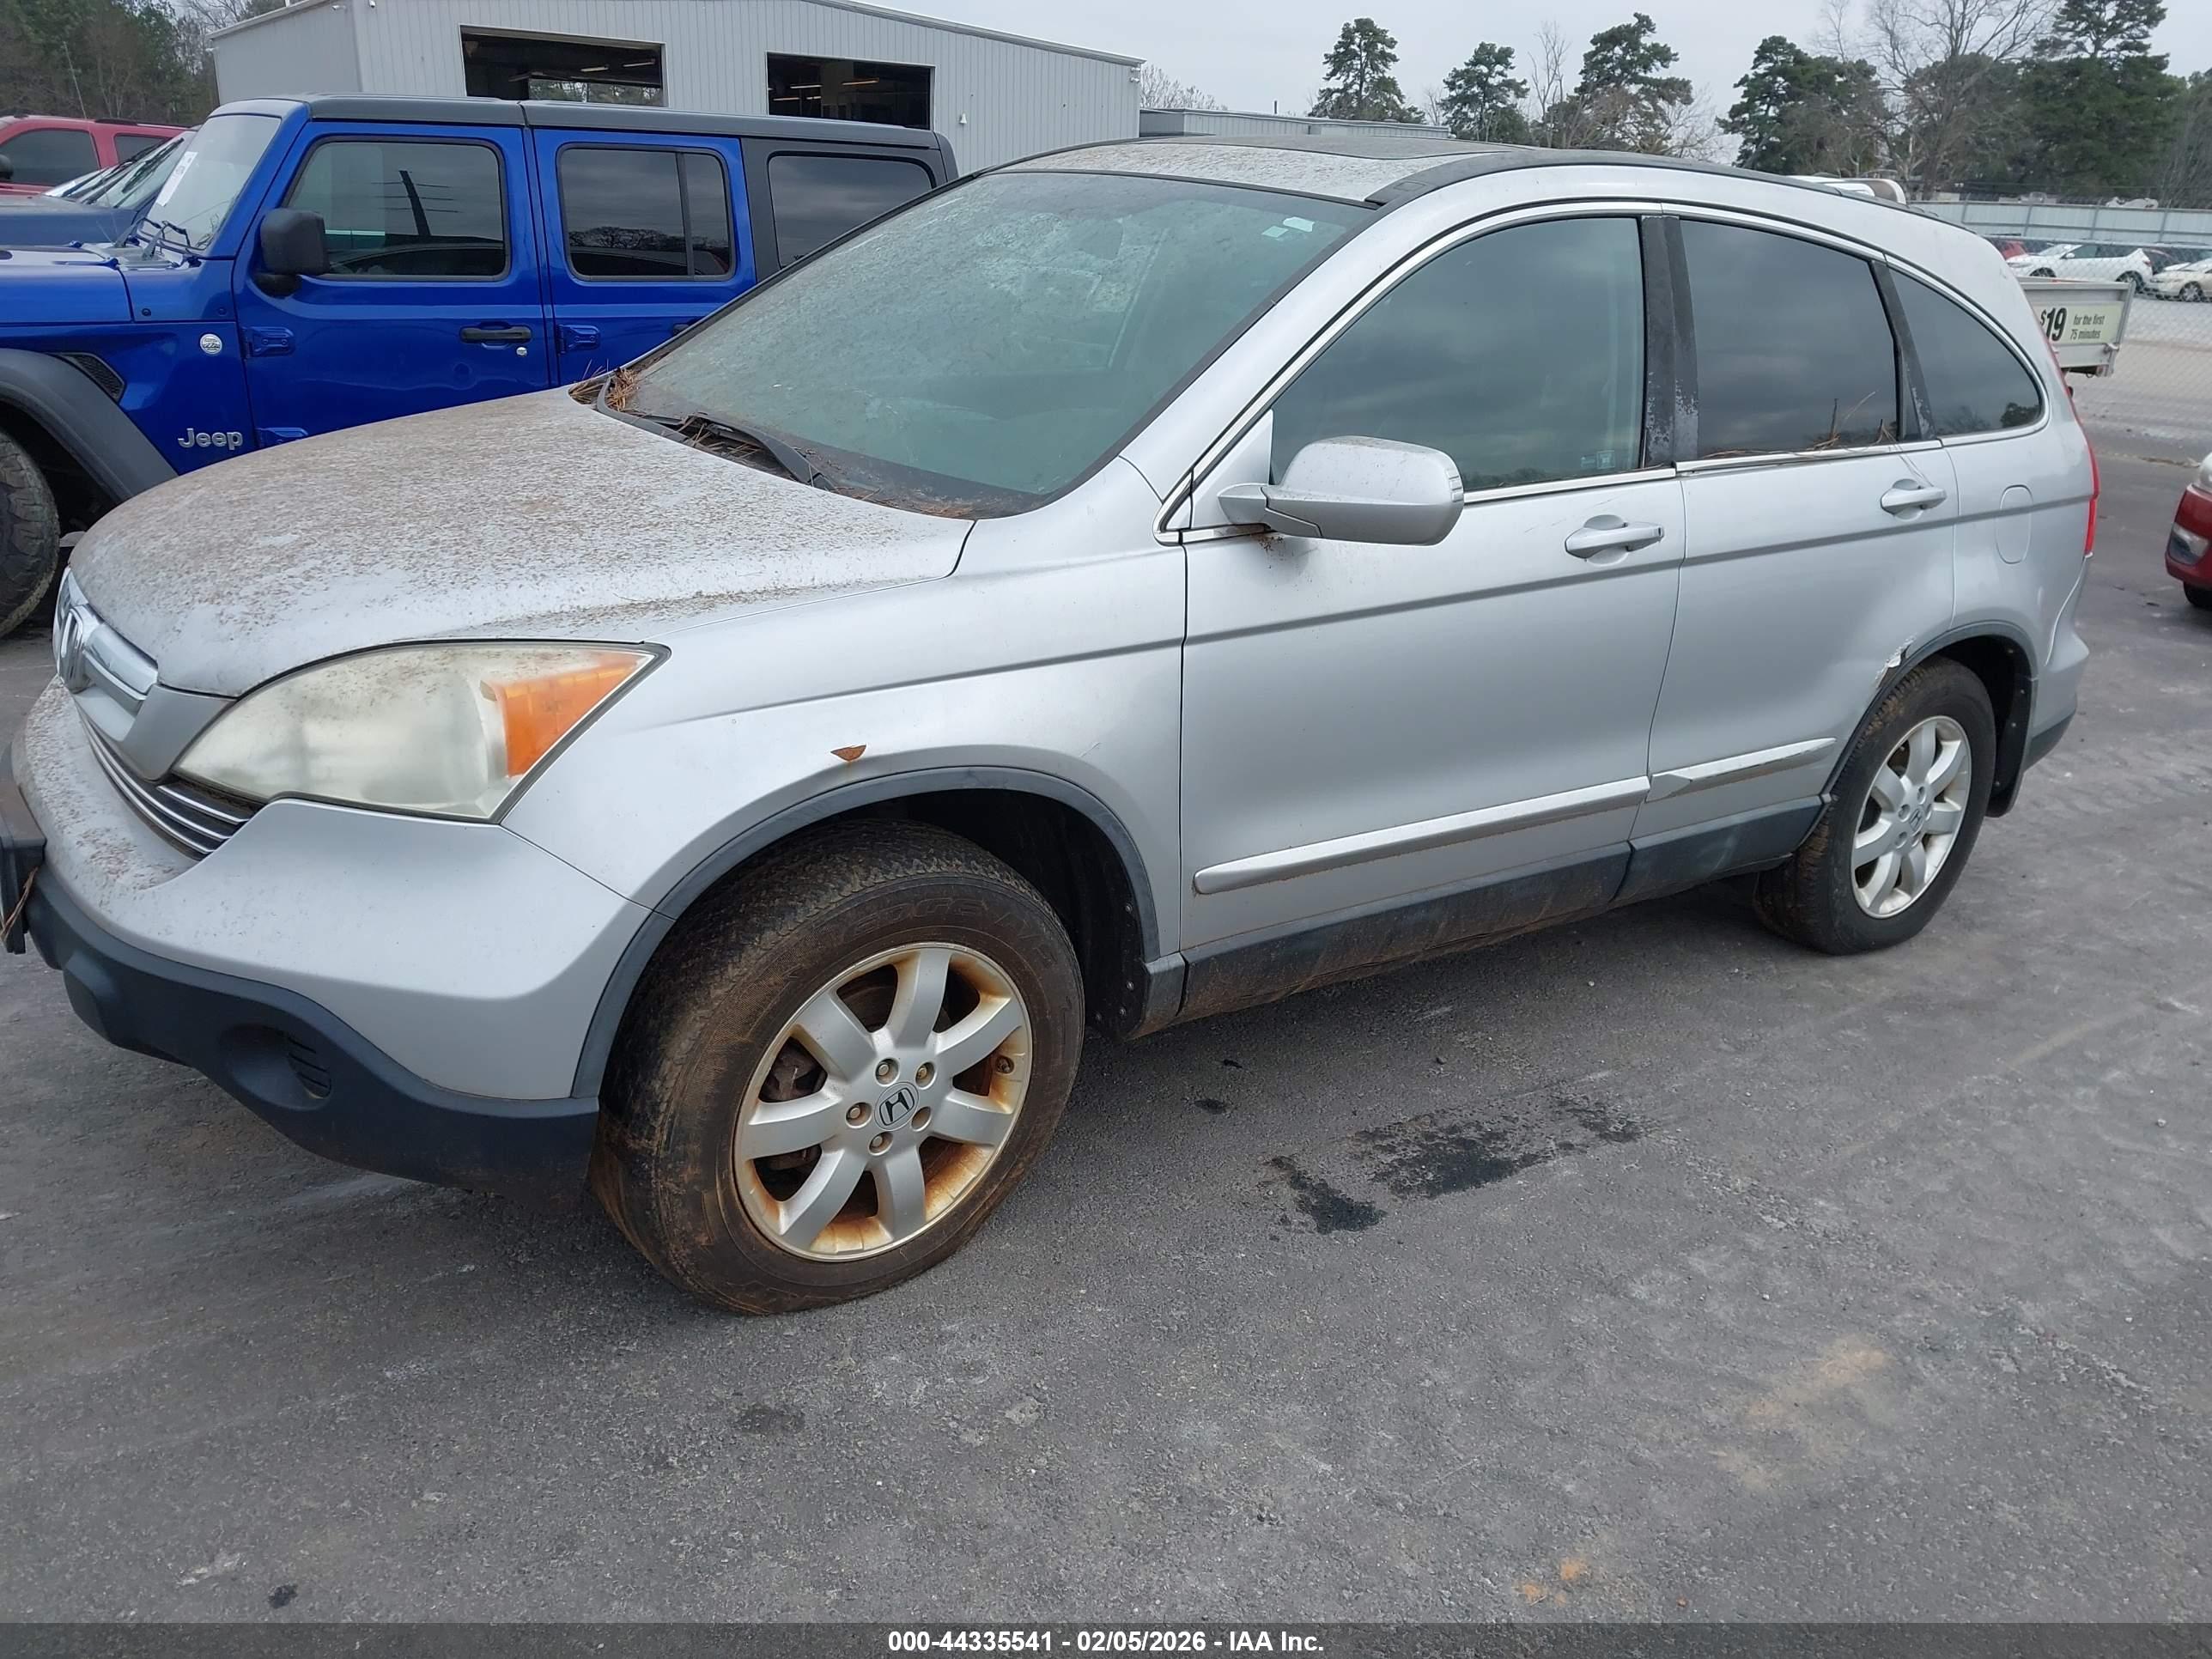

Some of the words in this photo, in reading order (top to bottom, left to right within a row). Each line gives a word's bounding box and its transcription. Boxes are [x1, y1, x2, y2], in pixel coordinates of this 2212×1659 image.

[2040, 307, 2067, 342] $19
[2073, 314, 2081, 325] for
[2082, 314, 2092, 325] the
[2093, 314, 2105, 325] first
[2070, 329, 2078, 340] 75
[2078, 330, 2101, 339] minutes
[177, 428, 243, 451] Jeep
